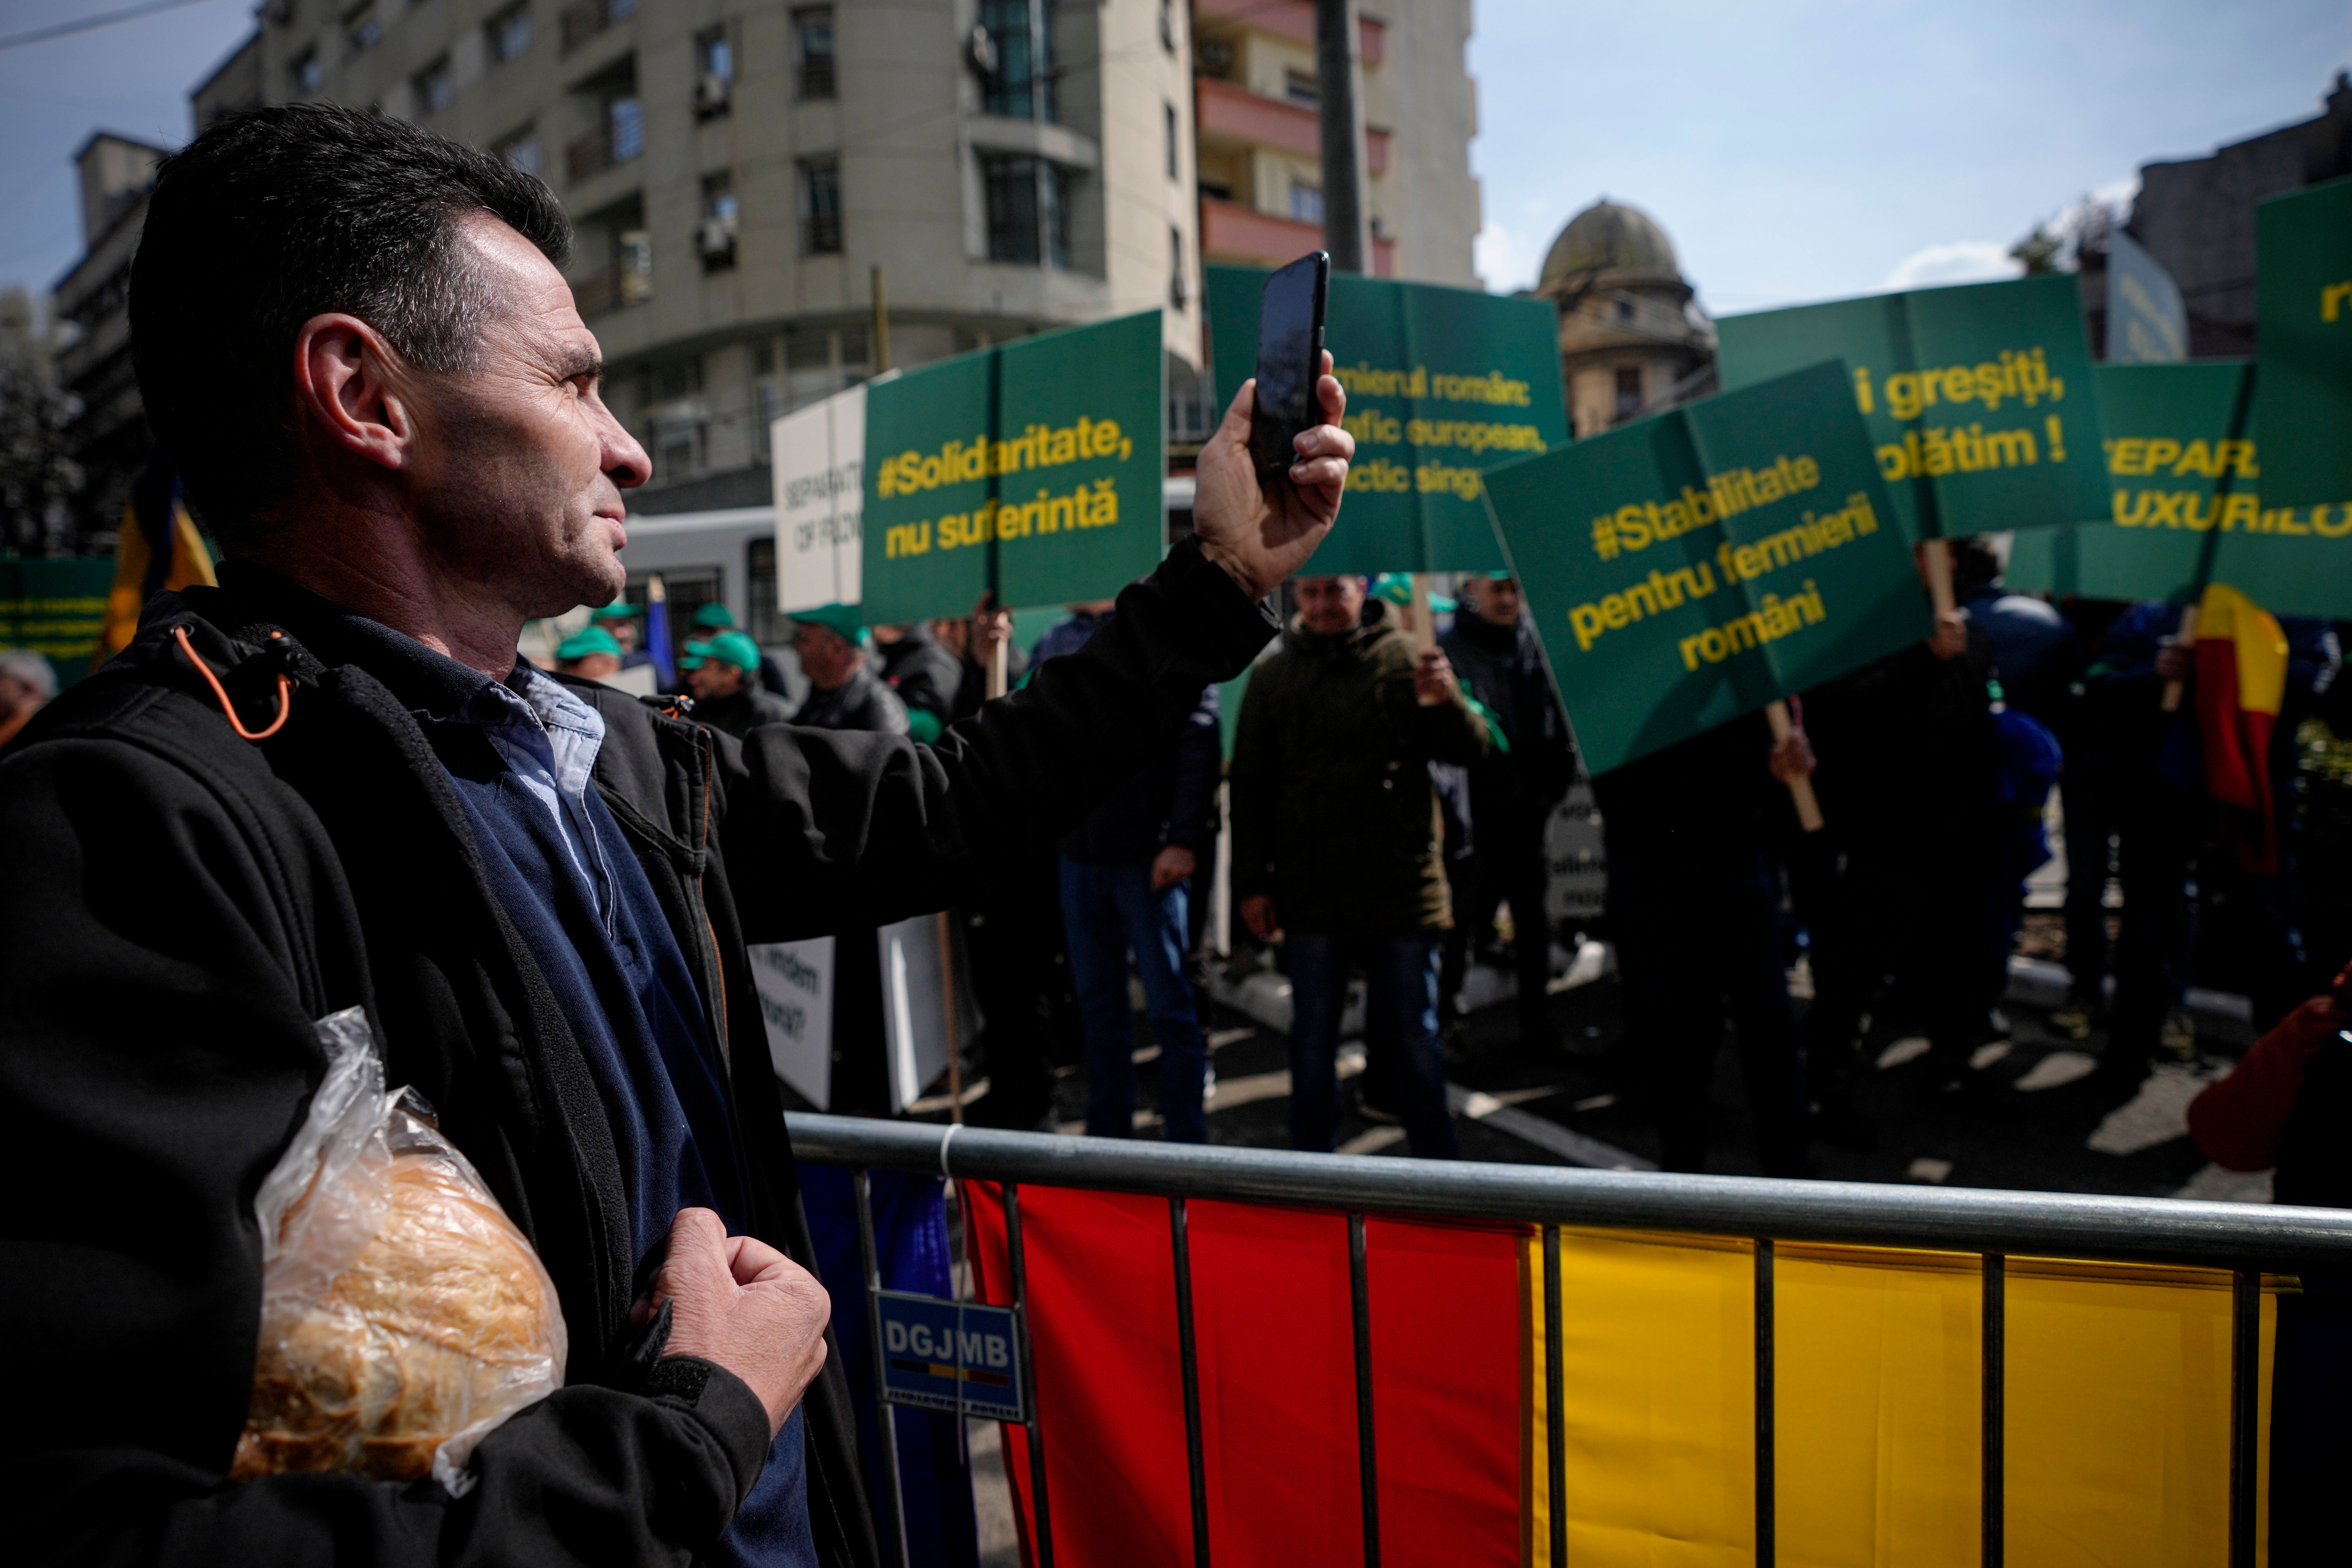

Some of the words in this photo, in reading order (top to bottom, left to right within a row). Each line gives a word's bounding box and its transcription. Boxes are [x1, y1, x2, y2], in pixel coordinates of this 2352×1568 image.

[876, 415, 1133, 499] #Solidaritate,
[2102, 437, 2261, 479] EPAR
[885, 520, 932, 559] nu
[1590, 455, 1820, 561] #Stabilitate
[1569, 560, 1716, 651] pentru
[1715, 491, 1878, 585] fermierii
[1679, 579, 1826, 671] români
[885, 1319, 1009, 1369] DGJMB
